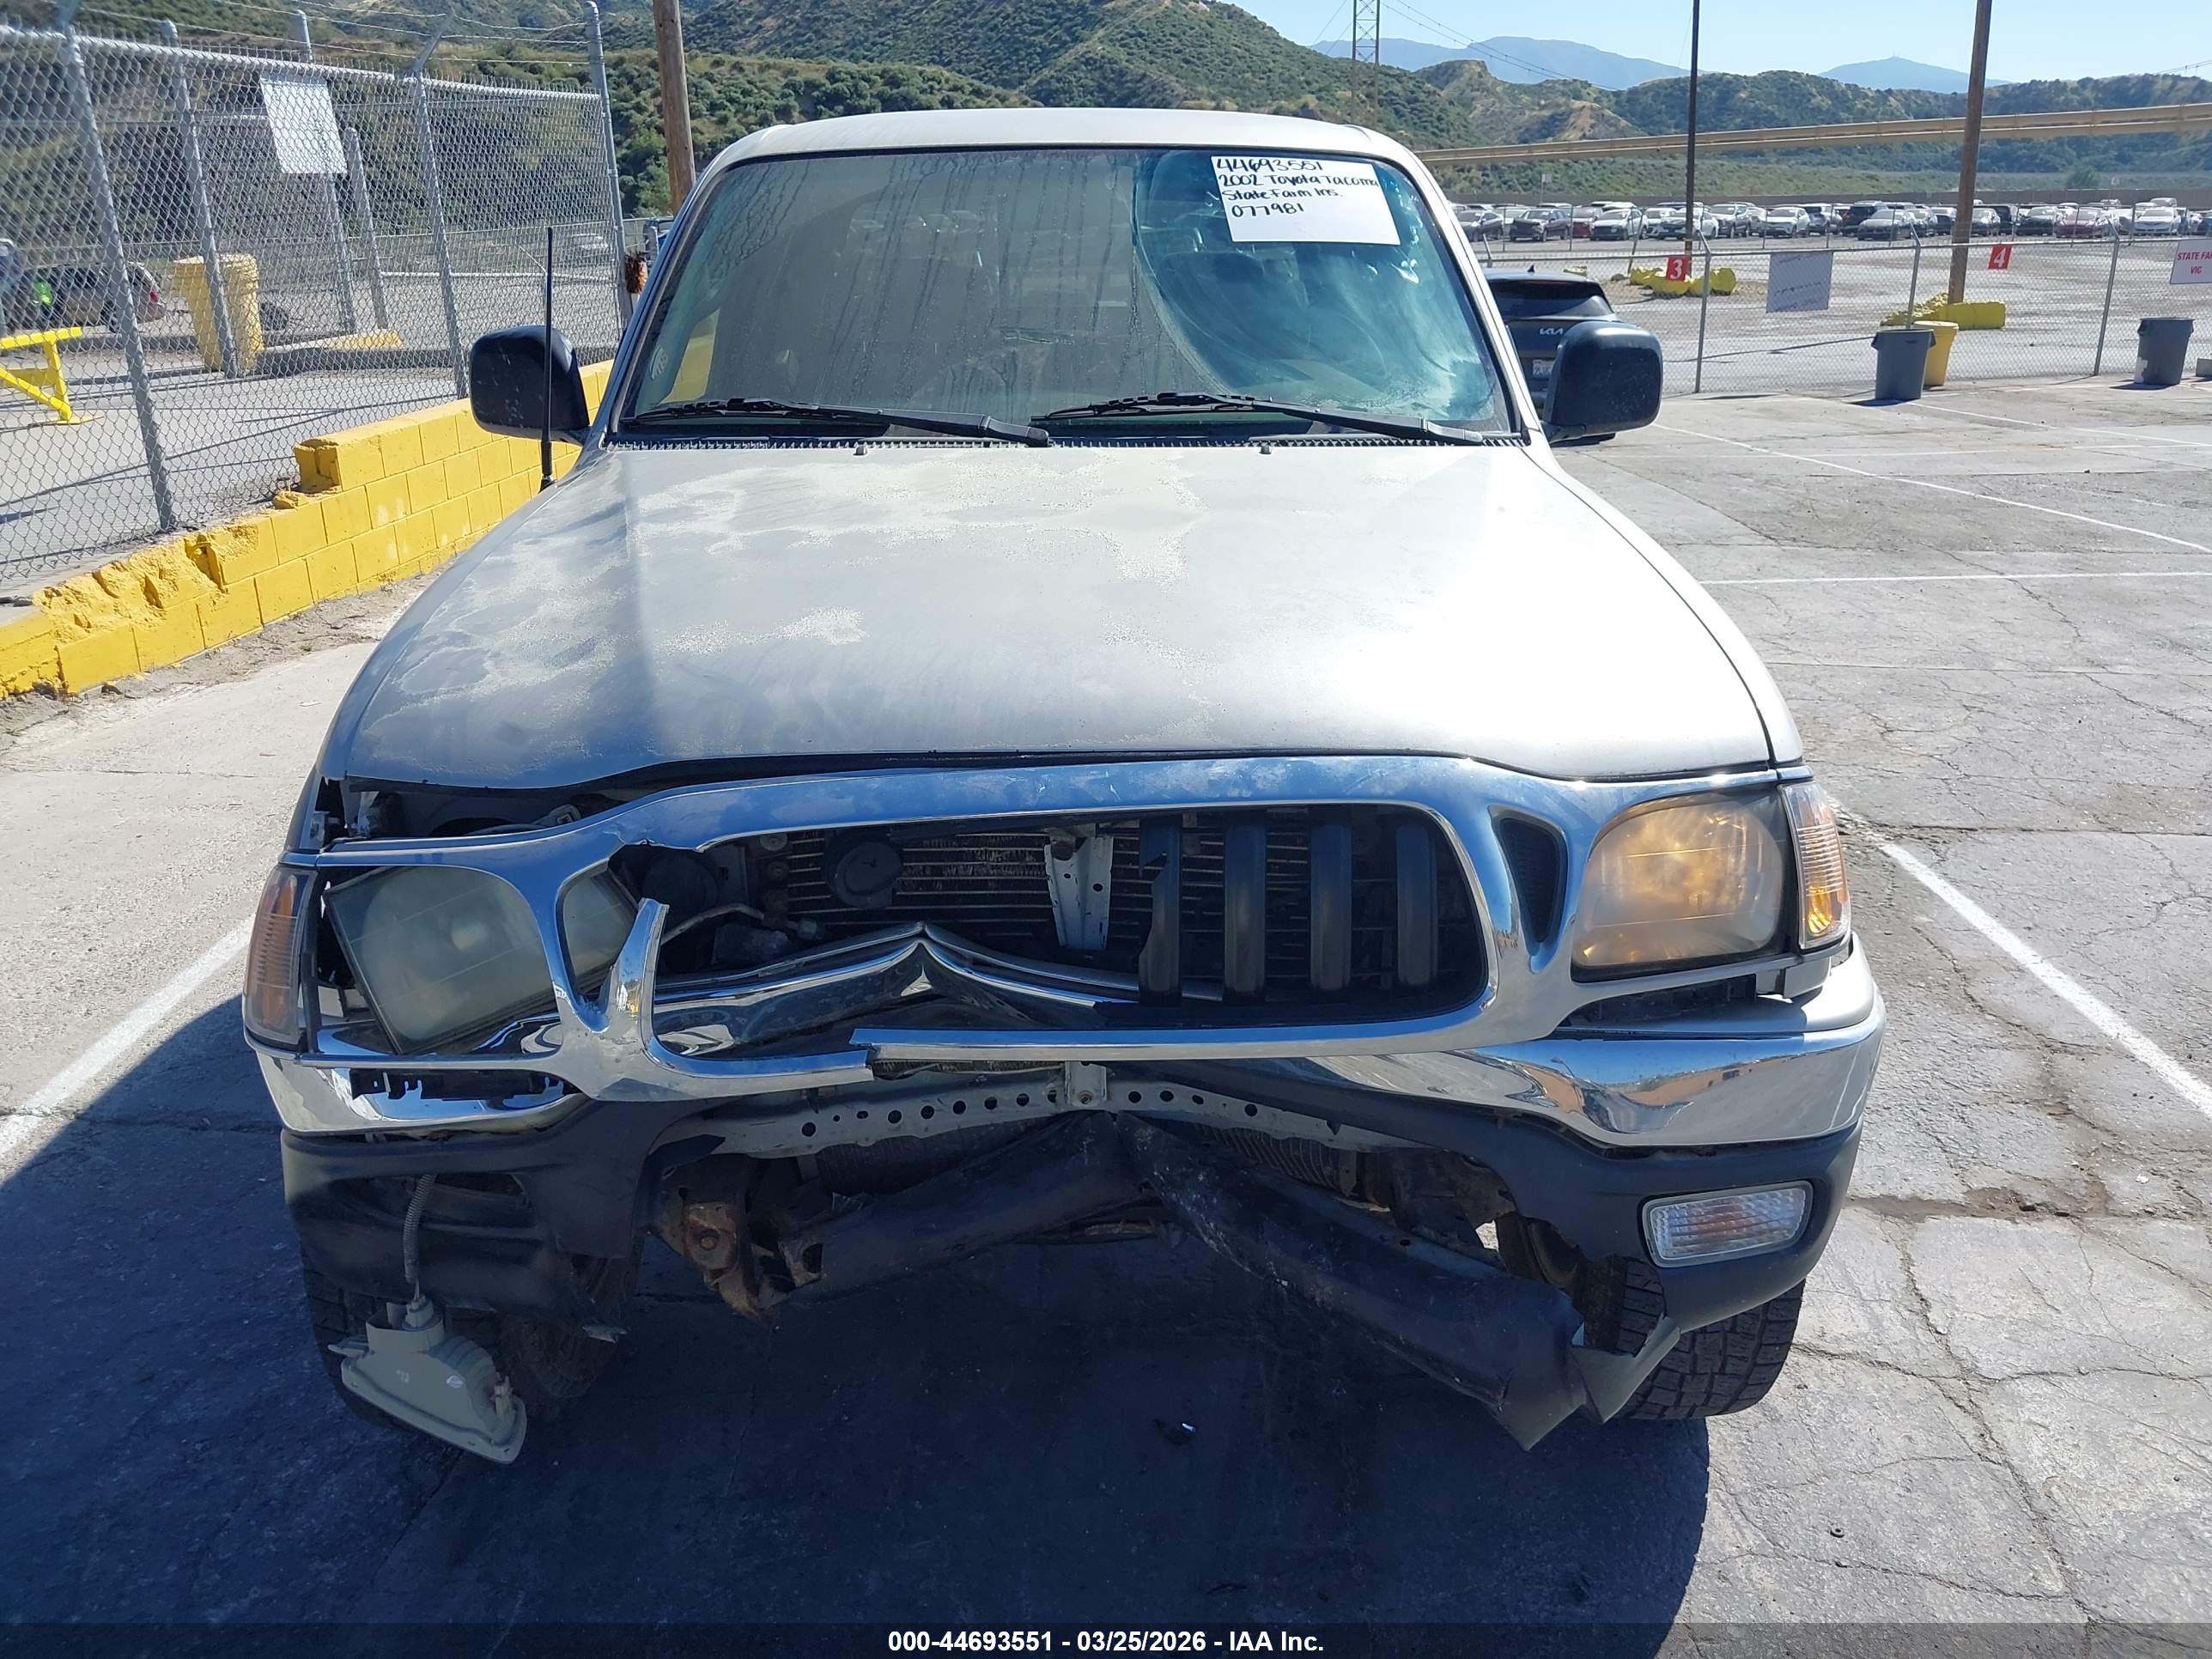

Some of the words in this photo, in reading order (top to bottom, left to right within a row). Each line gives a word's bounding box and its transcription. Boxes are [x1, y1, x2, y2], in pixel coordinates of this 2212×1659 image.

[1217, 158, 1322, 172] 44693551
[1218, 173, 1264, 186] 2002
[1264, 173, 1321, 185] Toyota
[1320, 175, 1379, 186] Tacoma
[1231, 203, 1304, 217] 077981
[1994, 247, 2006, 267] 4
[2177, 252, 2199, 261] STATE
[2201, 251, 2212, 260] FA
[1670, 259, 1683, 279] 3
